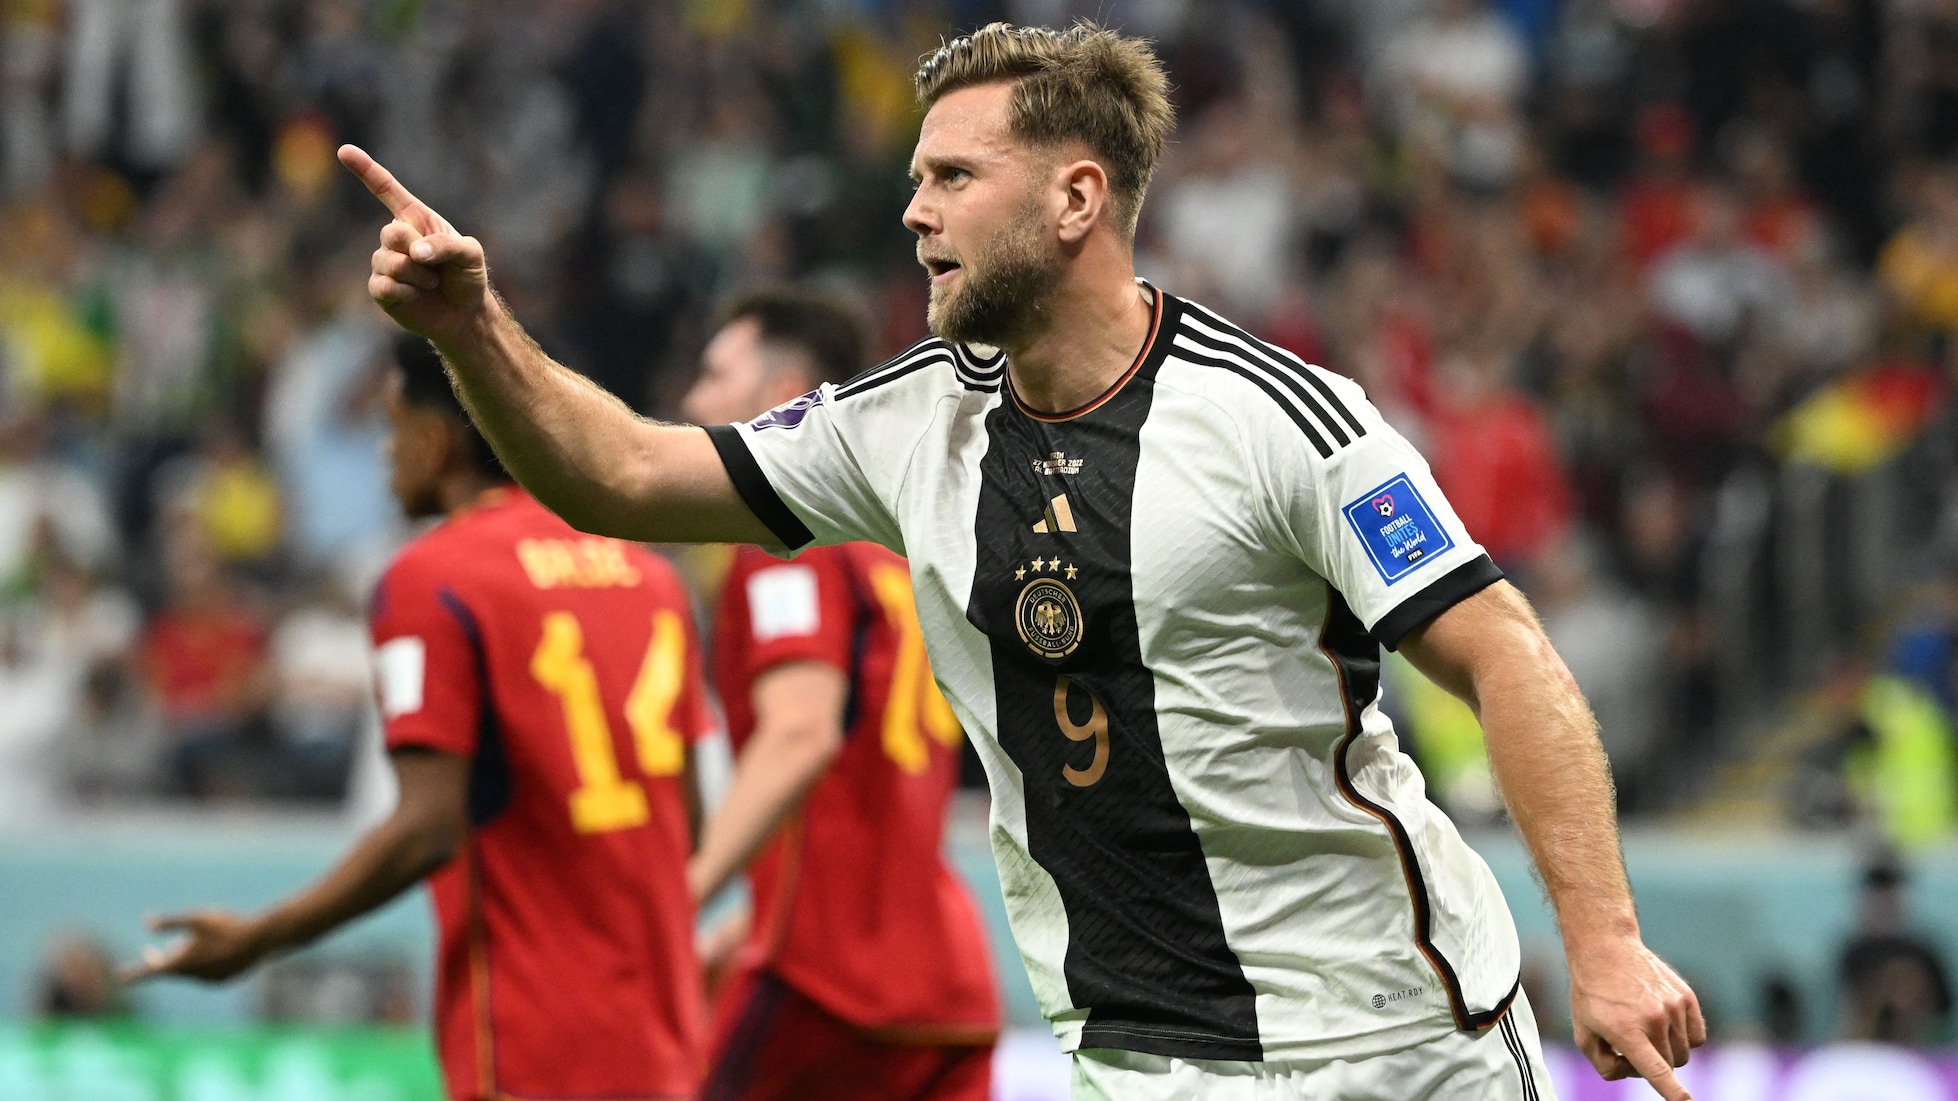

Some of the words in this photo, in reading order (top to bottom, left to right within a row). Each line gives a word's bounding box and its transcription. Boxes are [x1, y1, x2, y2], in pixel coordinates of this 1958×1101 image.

[1380, 513, 1413, 537] FOOTBALL
[1385, 521, 1418, 548] UNITES
[1391, 546, 1405, 559] the
[1402, 530, 1427, 551] World
[1407, 549, 1423, 562] FIFA
[1029, 588, 1067, 604] DEUTSCHER
[529, 609, 687, 836] 14
[1053, 675, 1110, 787] 9
